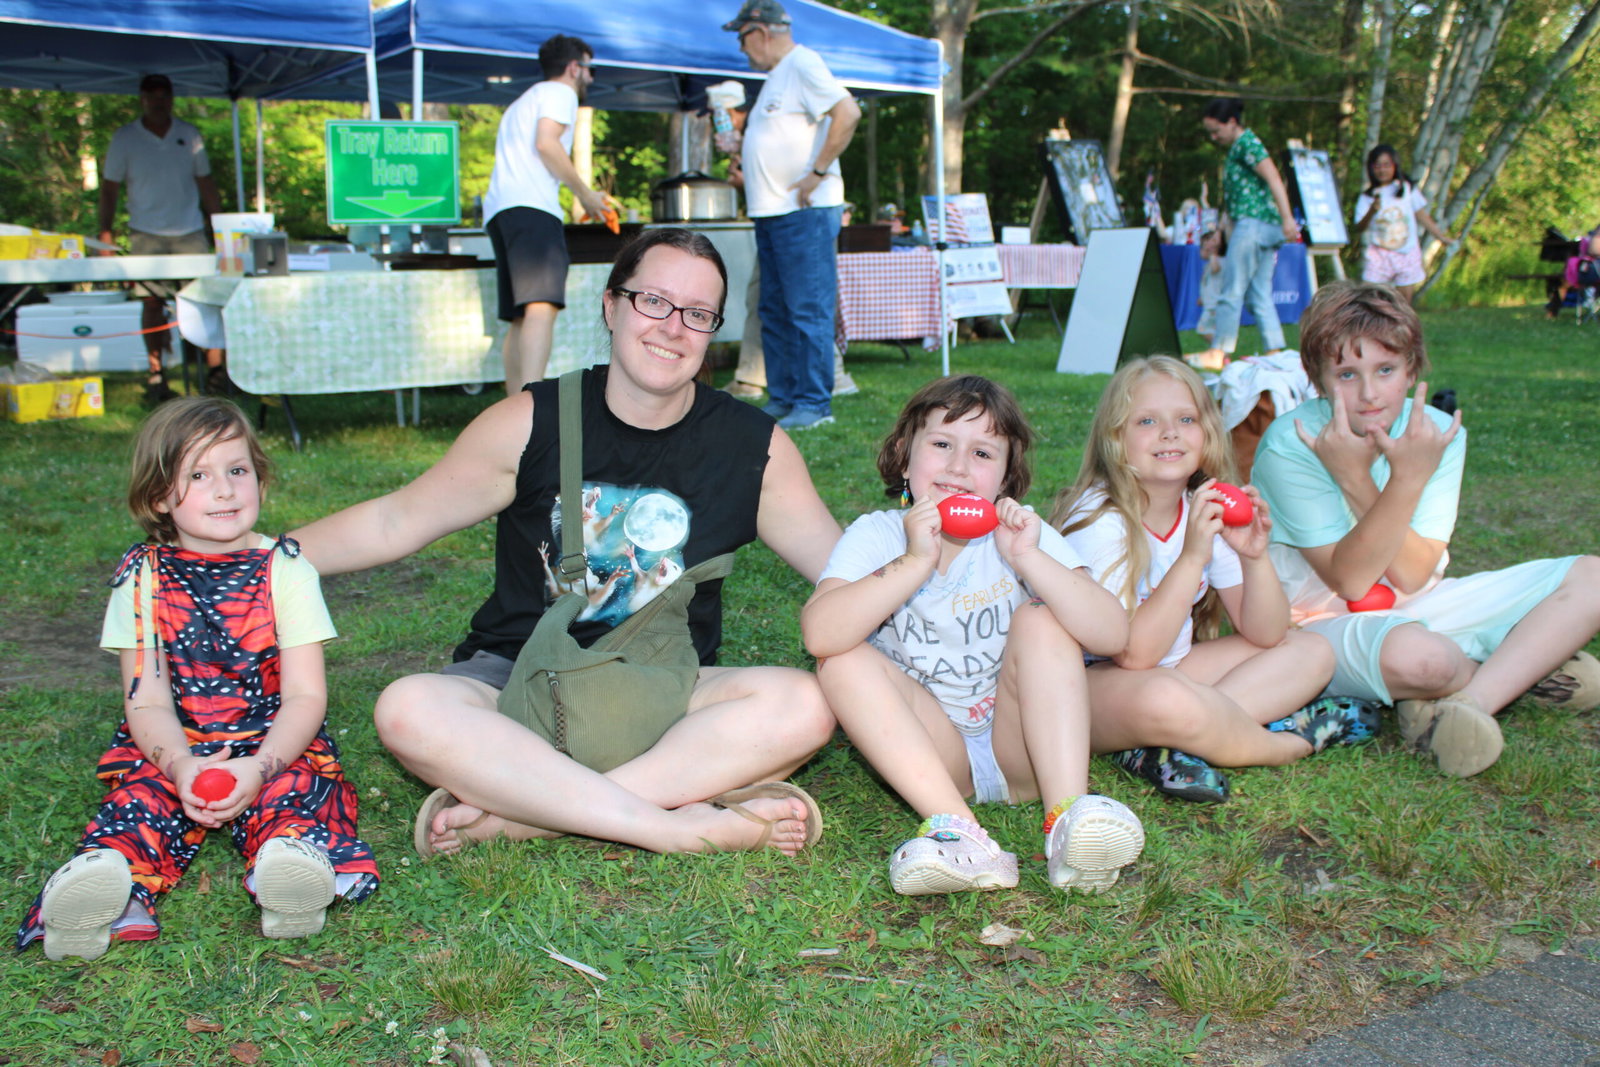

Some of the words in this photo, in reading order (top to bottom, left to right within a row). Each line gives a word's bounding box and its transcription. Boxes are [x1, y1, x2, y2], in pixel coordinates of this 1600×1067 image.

[337, 126, 379, 158] Tray
[383, 127, 449, 155] Return
[371, 158, 418, 186] Here
[951, 575, 1014, 616] FEARLESS
[878, 612, 940, 645] ARE
[955, 599, 1014, 645] YOU
